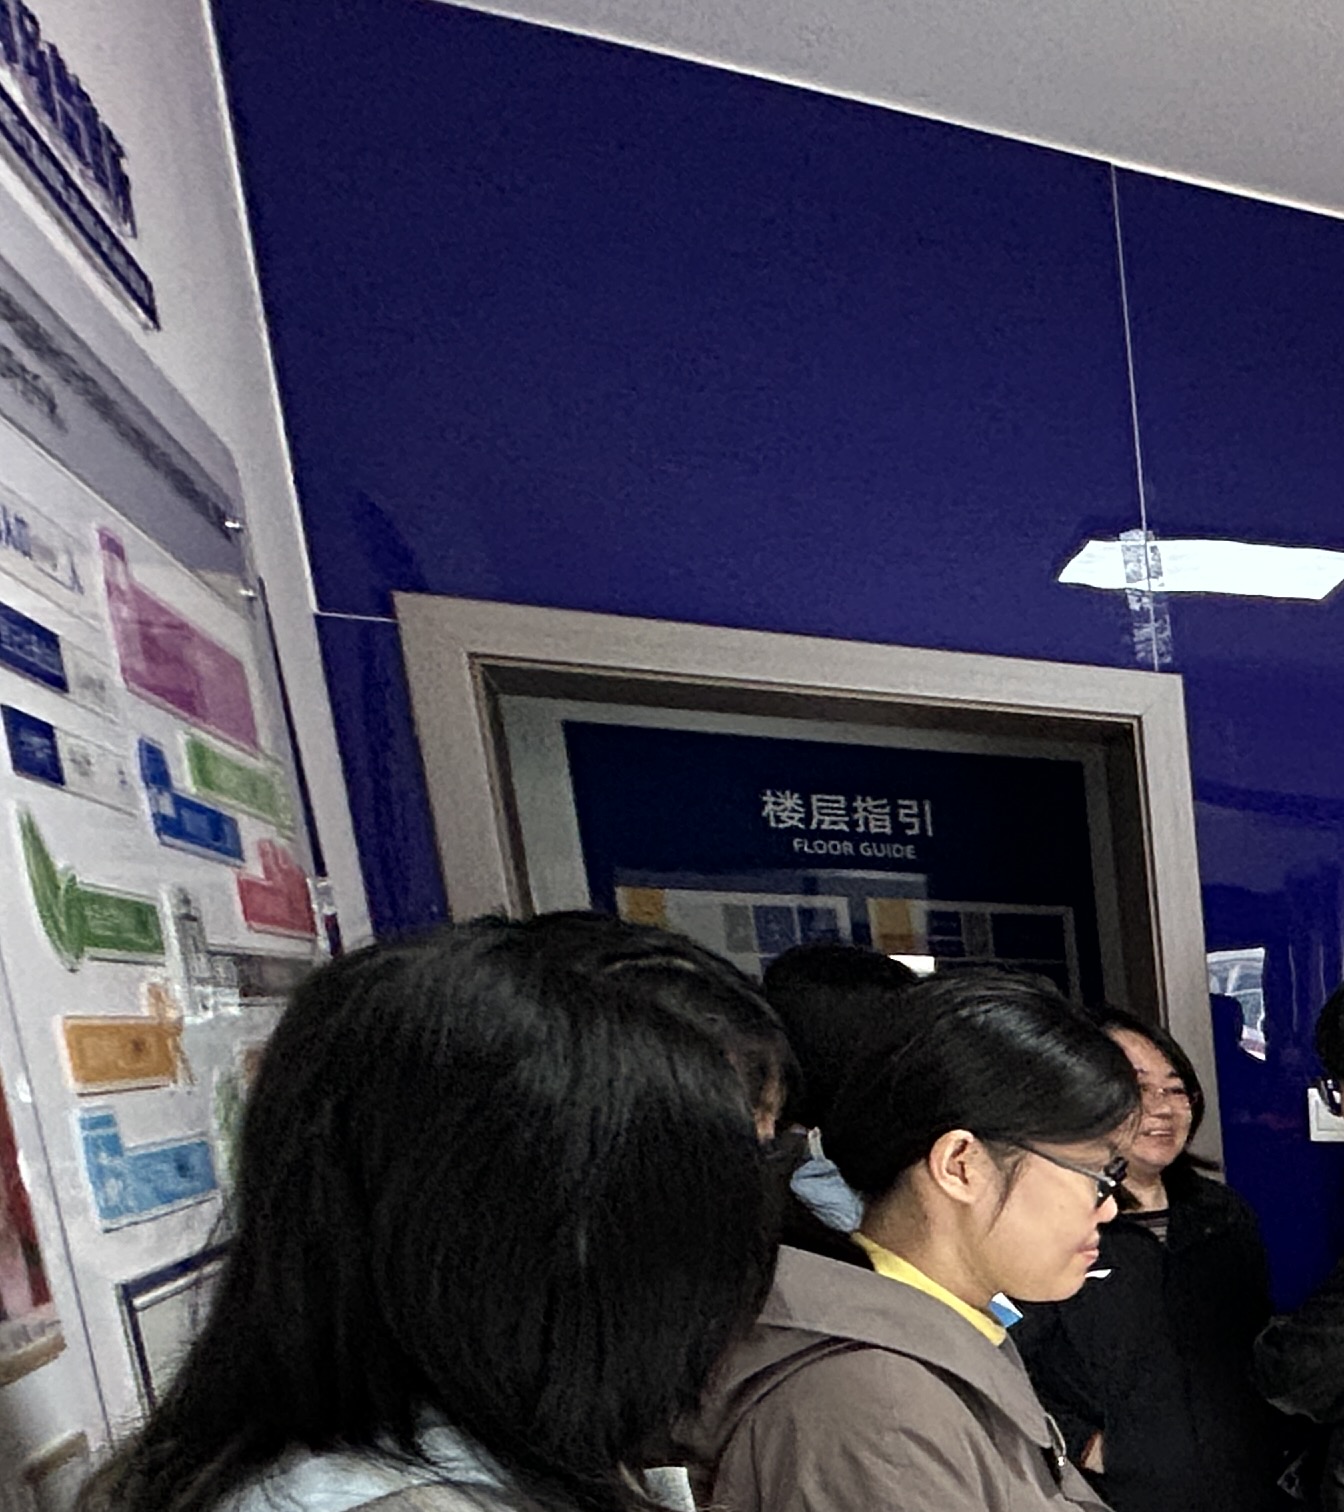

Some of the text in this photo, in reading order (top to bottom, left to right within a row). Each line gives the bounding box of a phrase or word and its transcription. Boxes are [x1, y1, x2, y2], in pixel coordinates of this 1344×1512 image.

[759, 789, 934, 837] 楼层指引
[793, 838, 918, 860] FLOOR GUIDE
